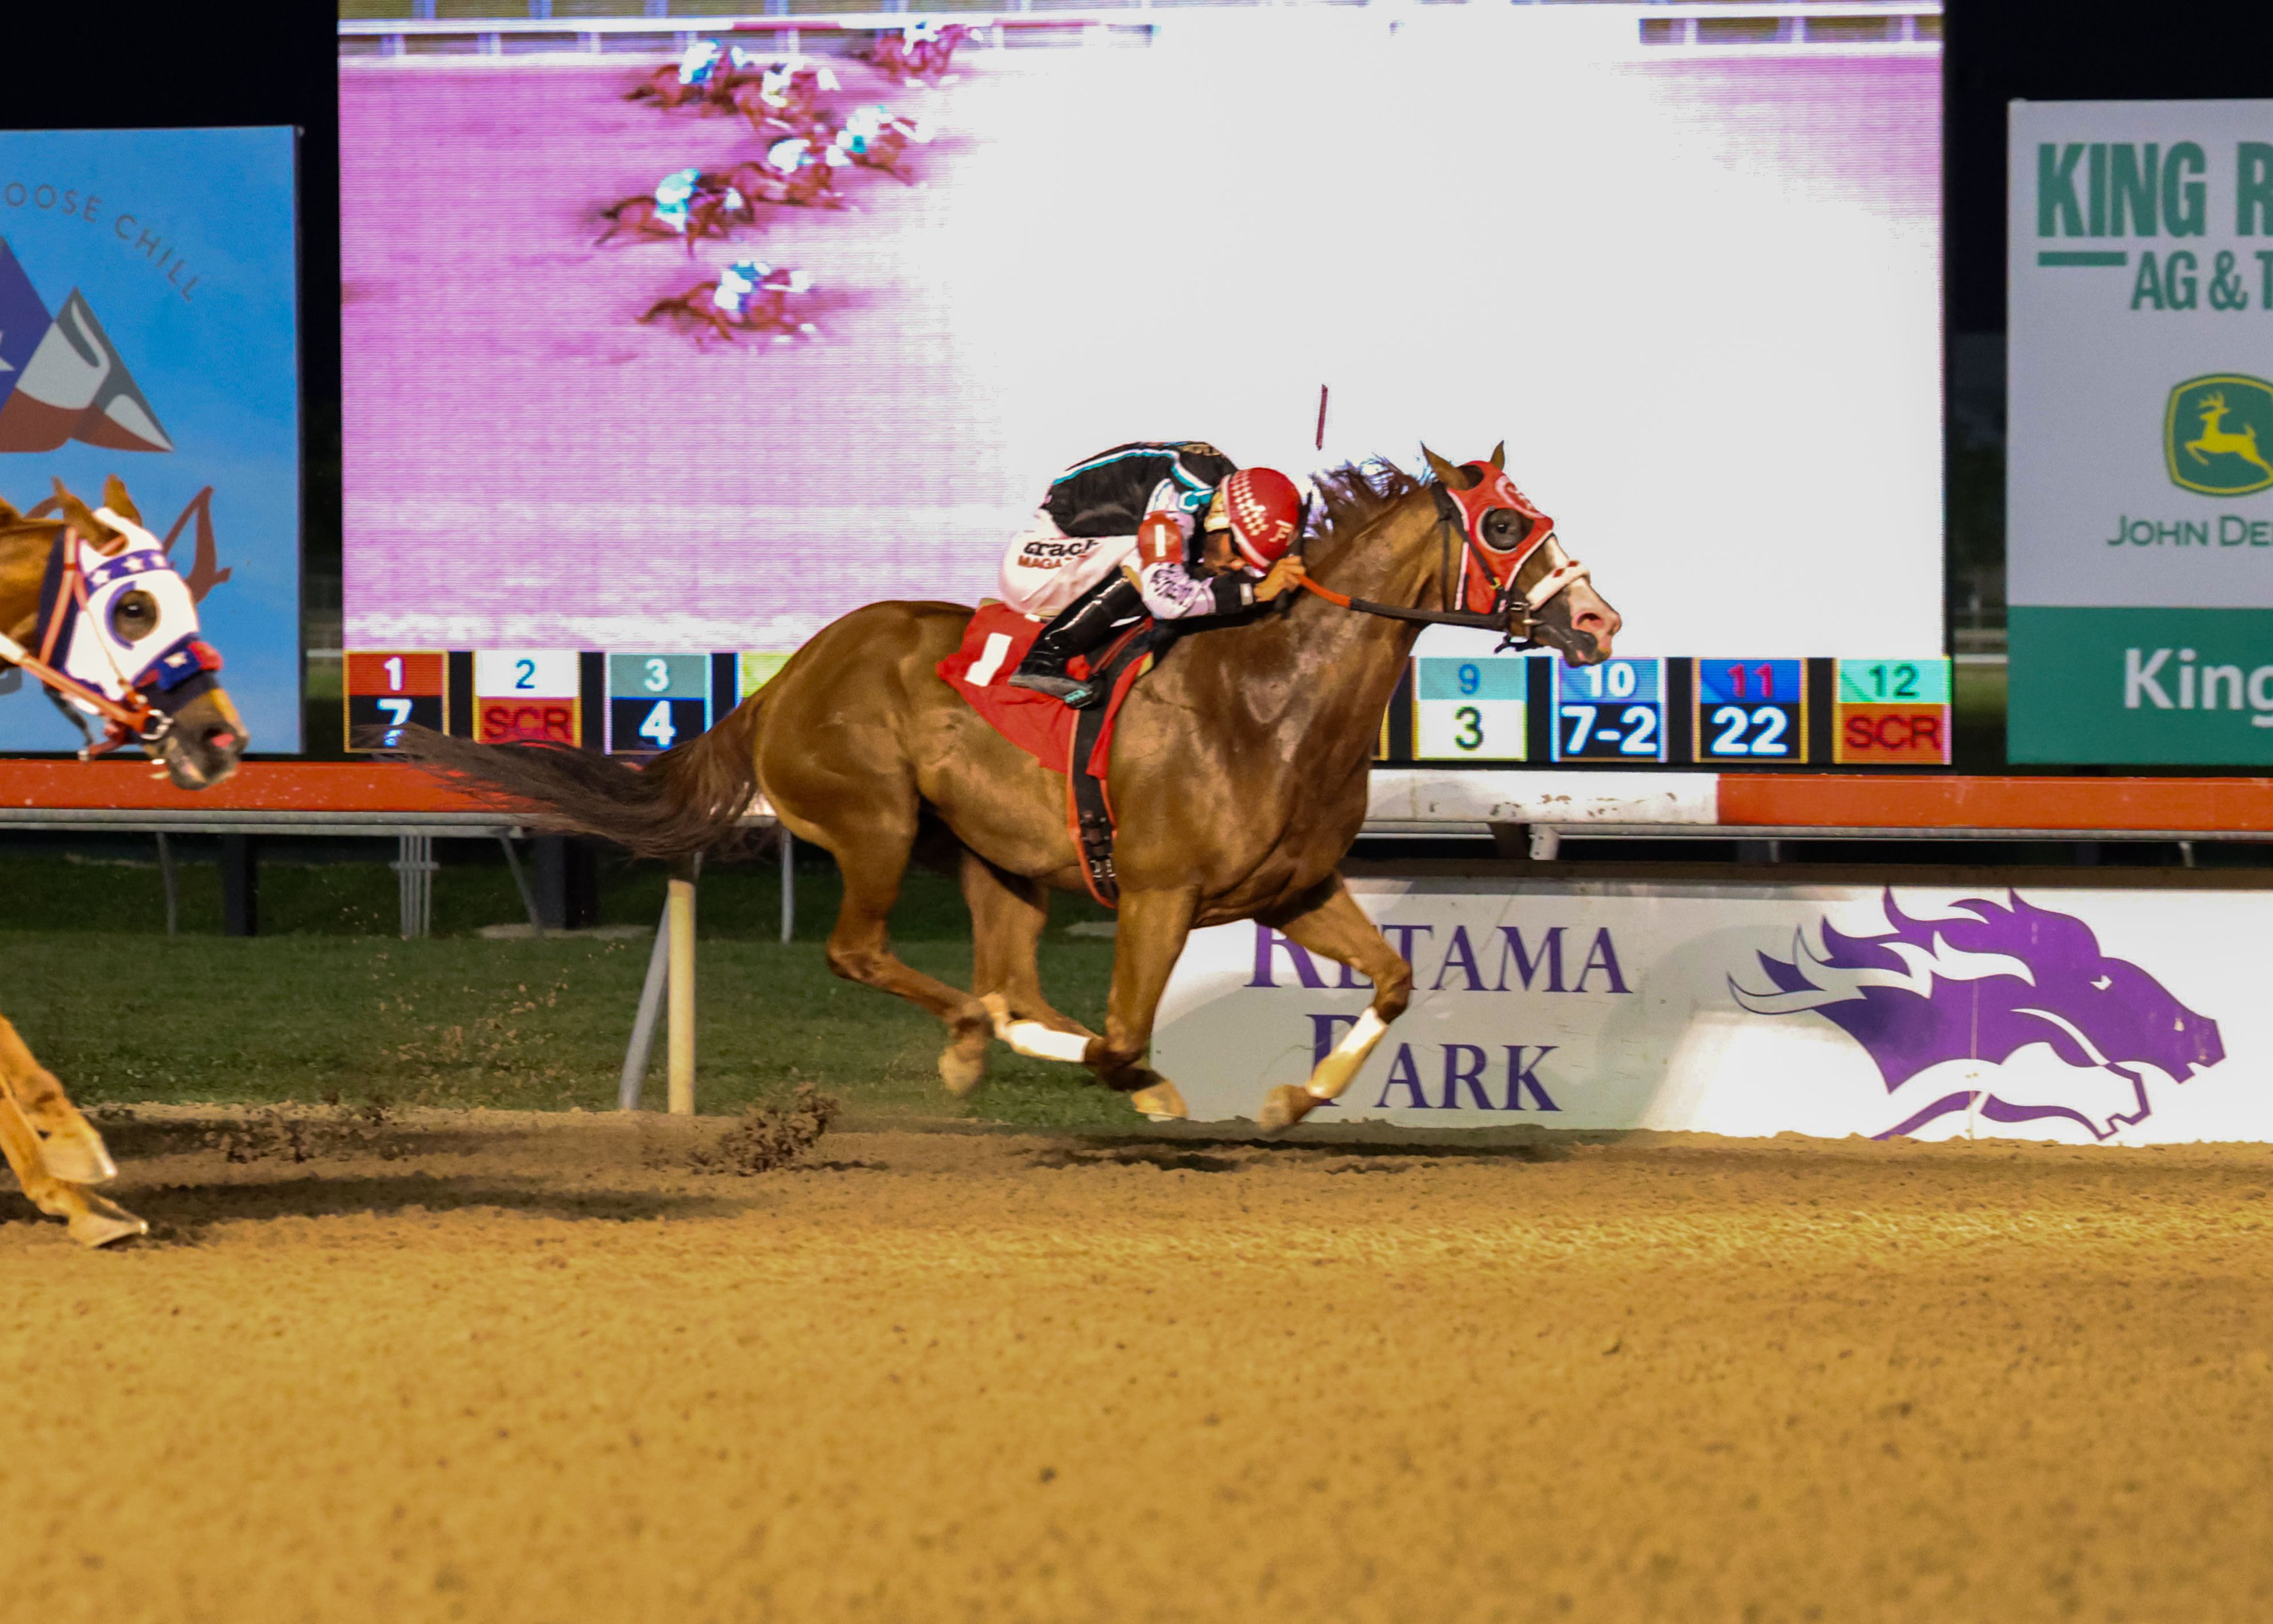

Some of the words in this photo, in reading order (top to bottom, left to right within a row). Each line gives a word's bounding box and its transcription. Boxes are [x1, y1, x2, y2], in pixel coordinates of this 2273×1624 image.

[2037, 141, 2206, 238] KING
[115, 214, 197, 302] CHILL
[2130, 250, 2198, 311] AG
[2208, 249, 2248, 311] &
[2107, 515, 2208, 546] JOHN
[2219, 514, 2273, 546] DE
[383, 657, 403, 691] 1
[515, 659, 536, 689] 2
[643, 658, 670, 692] 3
[964, 633, 1013, 687] 1
[1458, 663, 1481, 695] 9
[1584, 662, 1635, 697] 10
[1727, 662, 1773, 698] 11
[1868, 663, 1920, 699] 12
[377, 698, 413, 746] 7
[484, 706, 570, 739] SCR
[639, 700, 677, 749] 4
[1454, 705, 1484, 751] 3
[1560, 705, 1658, 755] 7-2
[1710, 705, 1789, 756] 22
[1846, 714, 1941, 751] SCR
